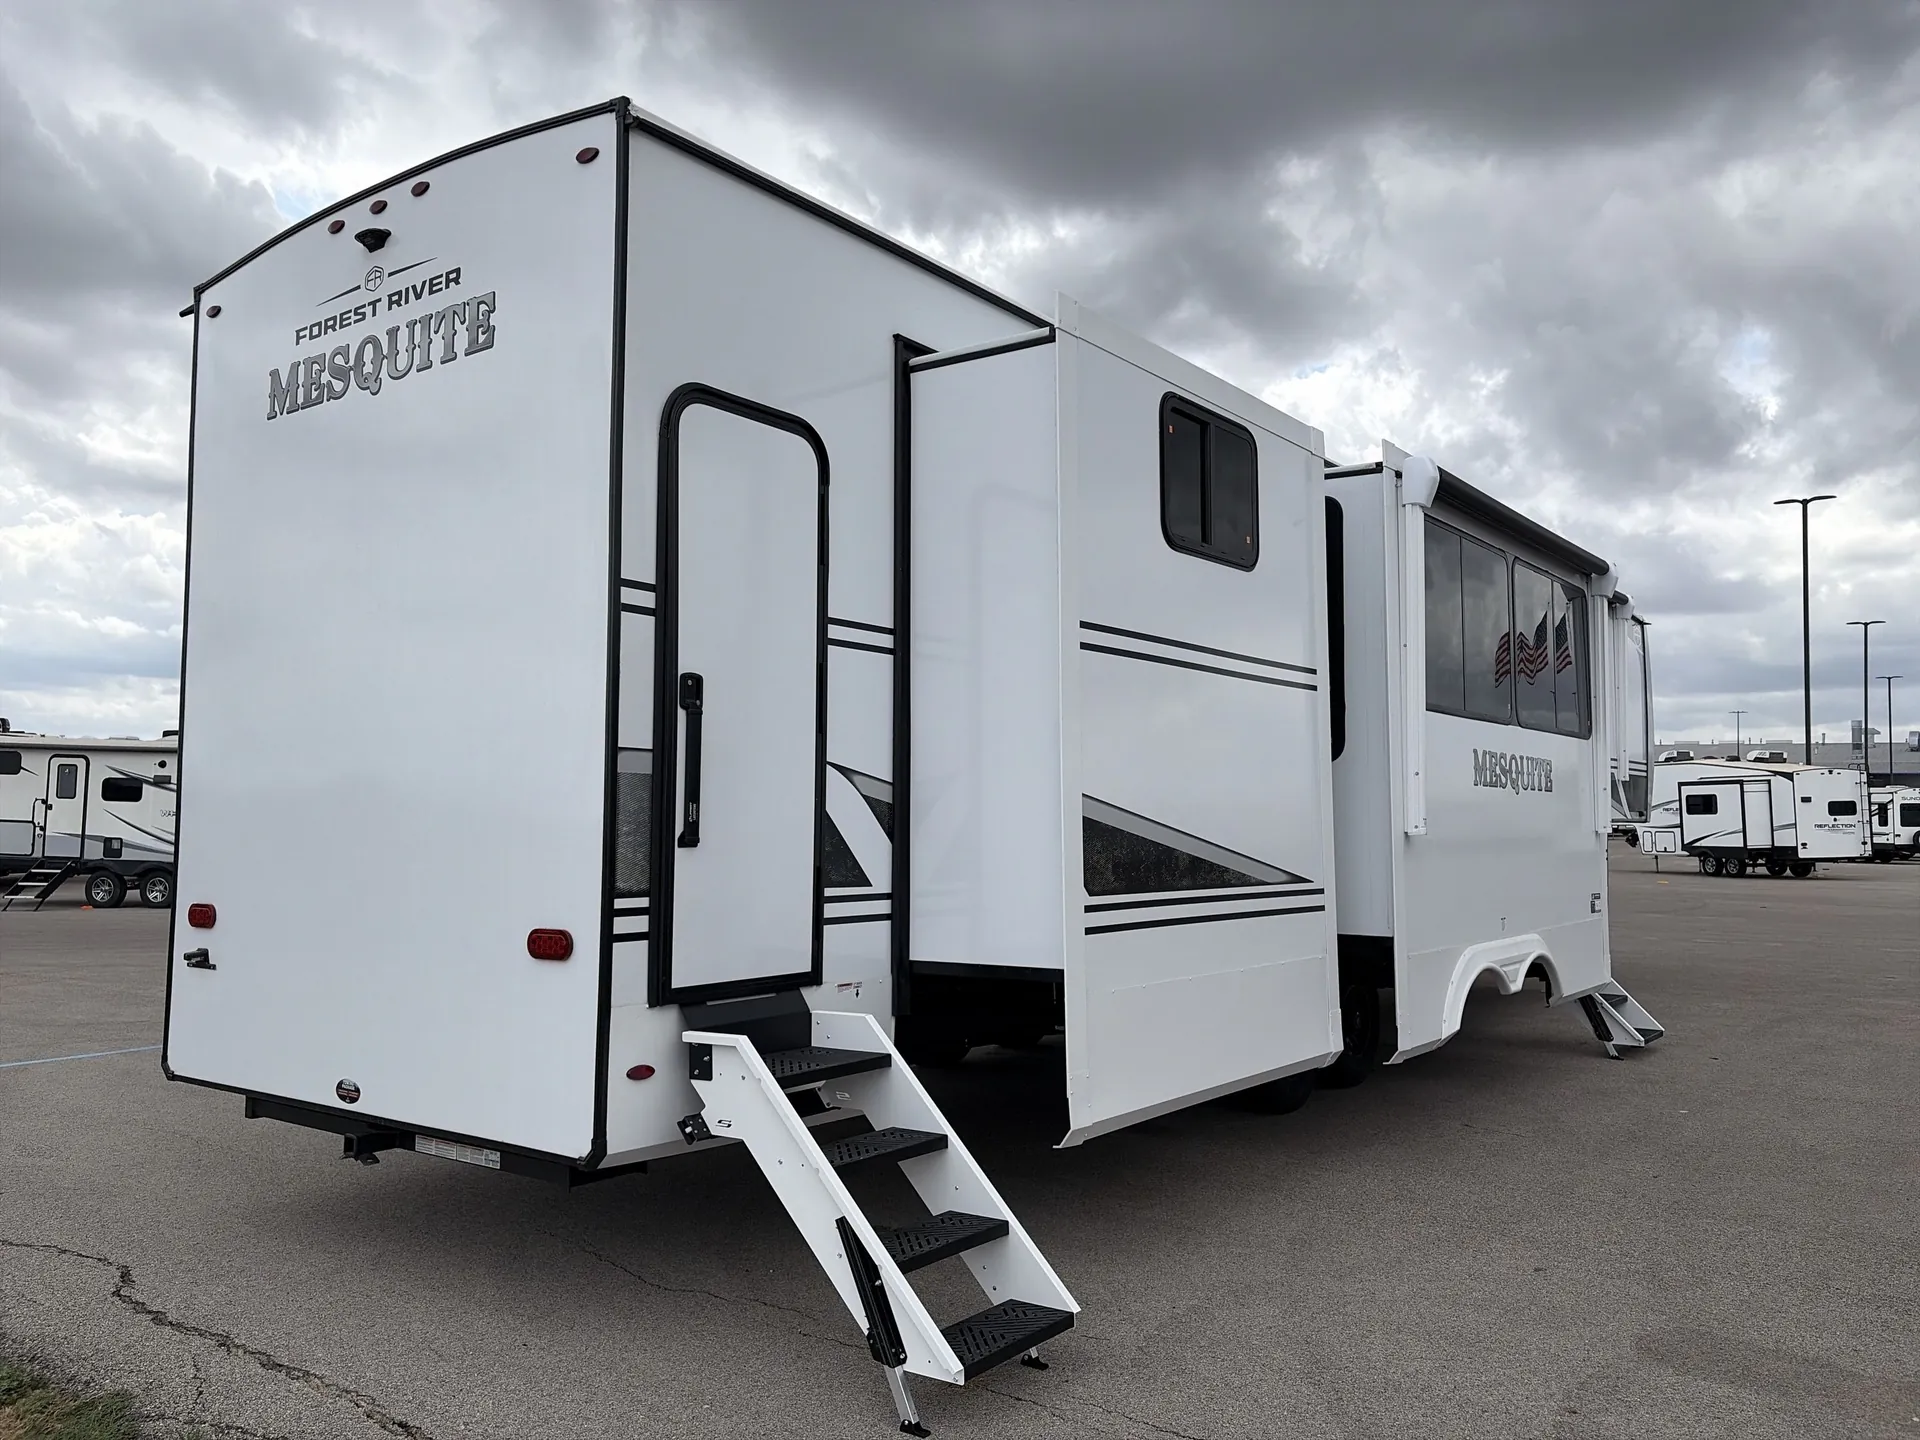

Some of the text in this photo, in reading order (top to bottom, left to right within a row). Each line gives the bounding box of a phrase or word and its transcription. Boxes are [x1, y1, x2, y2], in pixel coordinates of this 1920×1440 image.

[295, 266, 461, 346] FOREST RIVER
[267, 291, 496, 421] MESQUITE
[1473, 748, 1553, 795] MESQUITE
